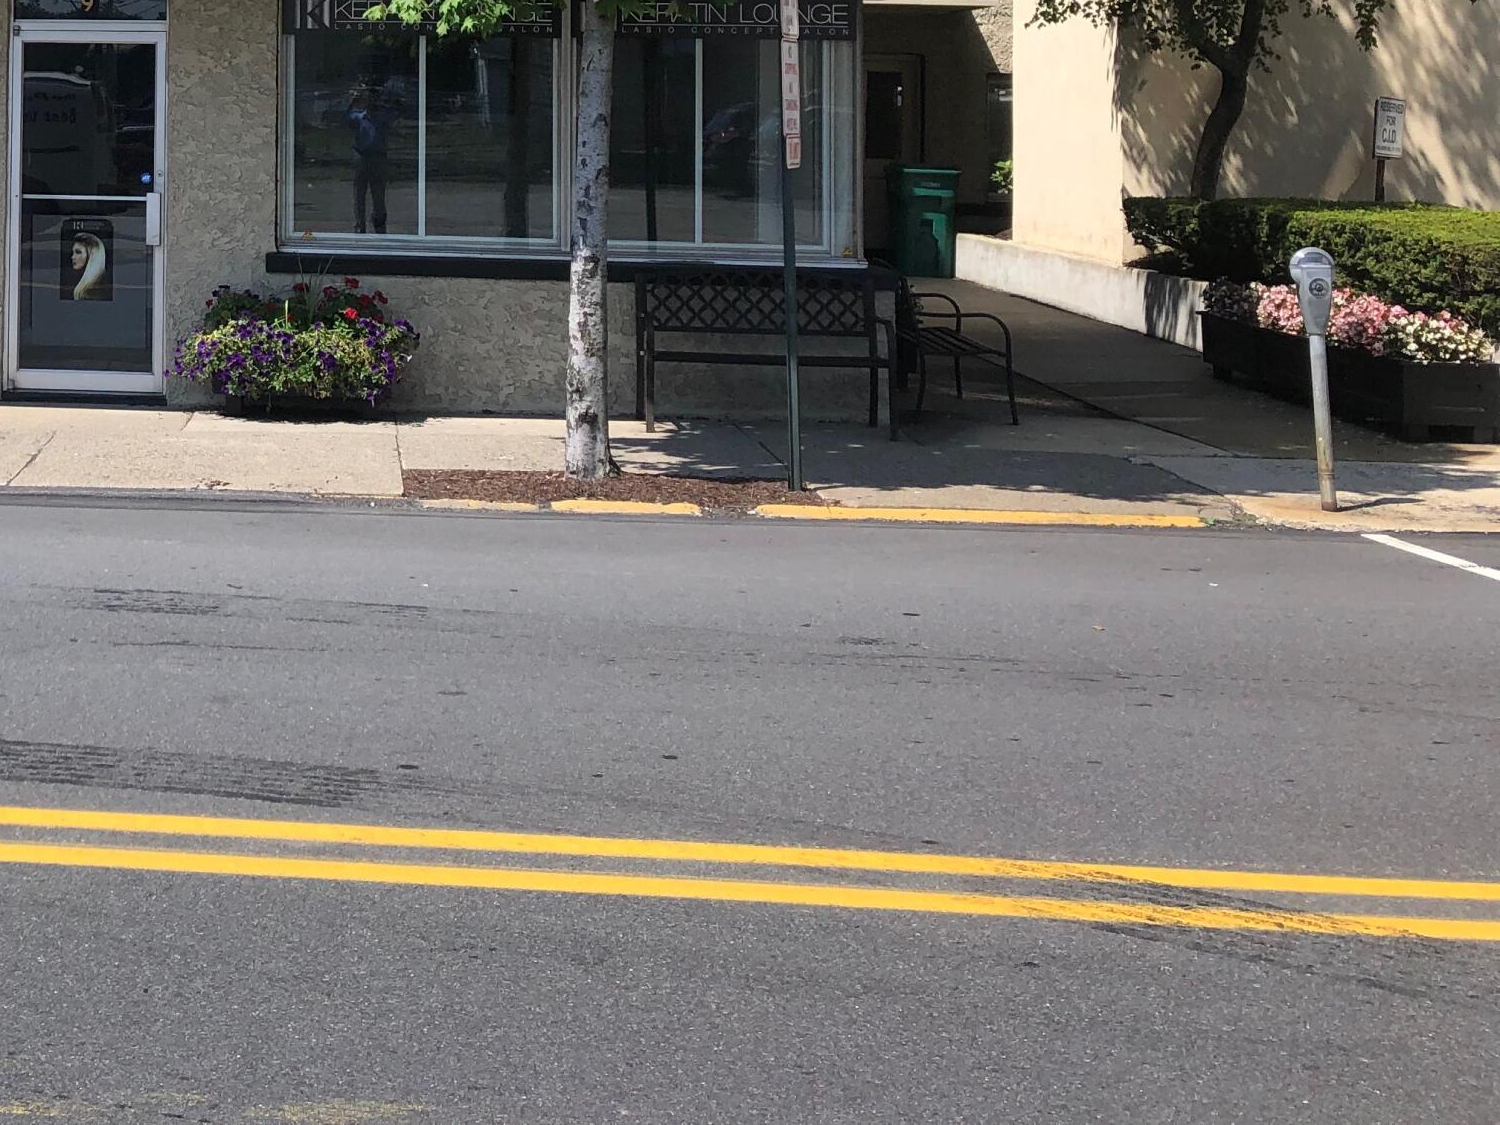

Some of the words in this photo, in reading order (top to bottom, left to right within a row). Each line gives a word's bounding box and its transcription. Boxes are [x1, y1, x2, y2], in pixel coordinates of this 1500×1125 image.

[334, 23, 386, 31] LASIO
[621, 26, 676, 34] LASIO
[691, 26, 775, 35] CONCEPT
[802, 28, 850, 36] ALON
